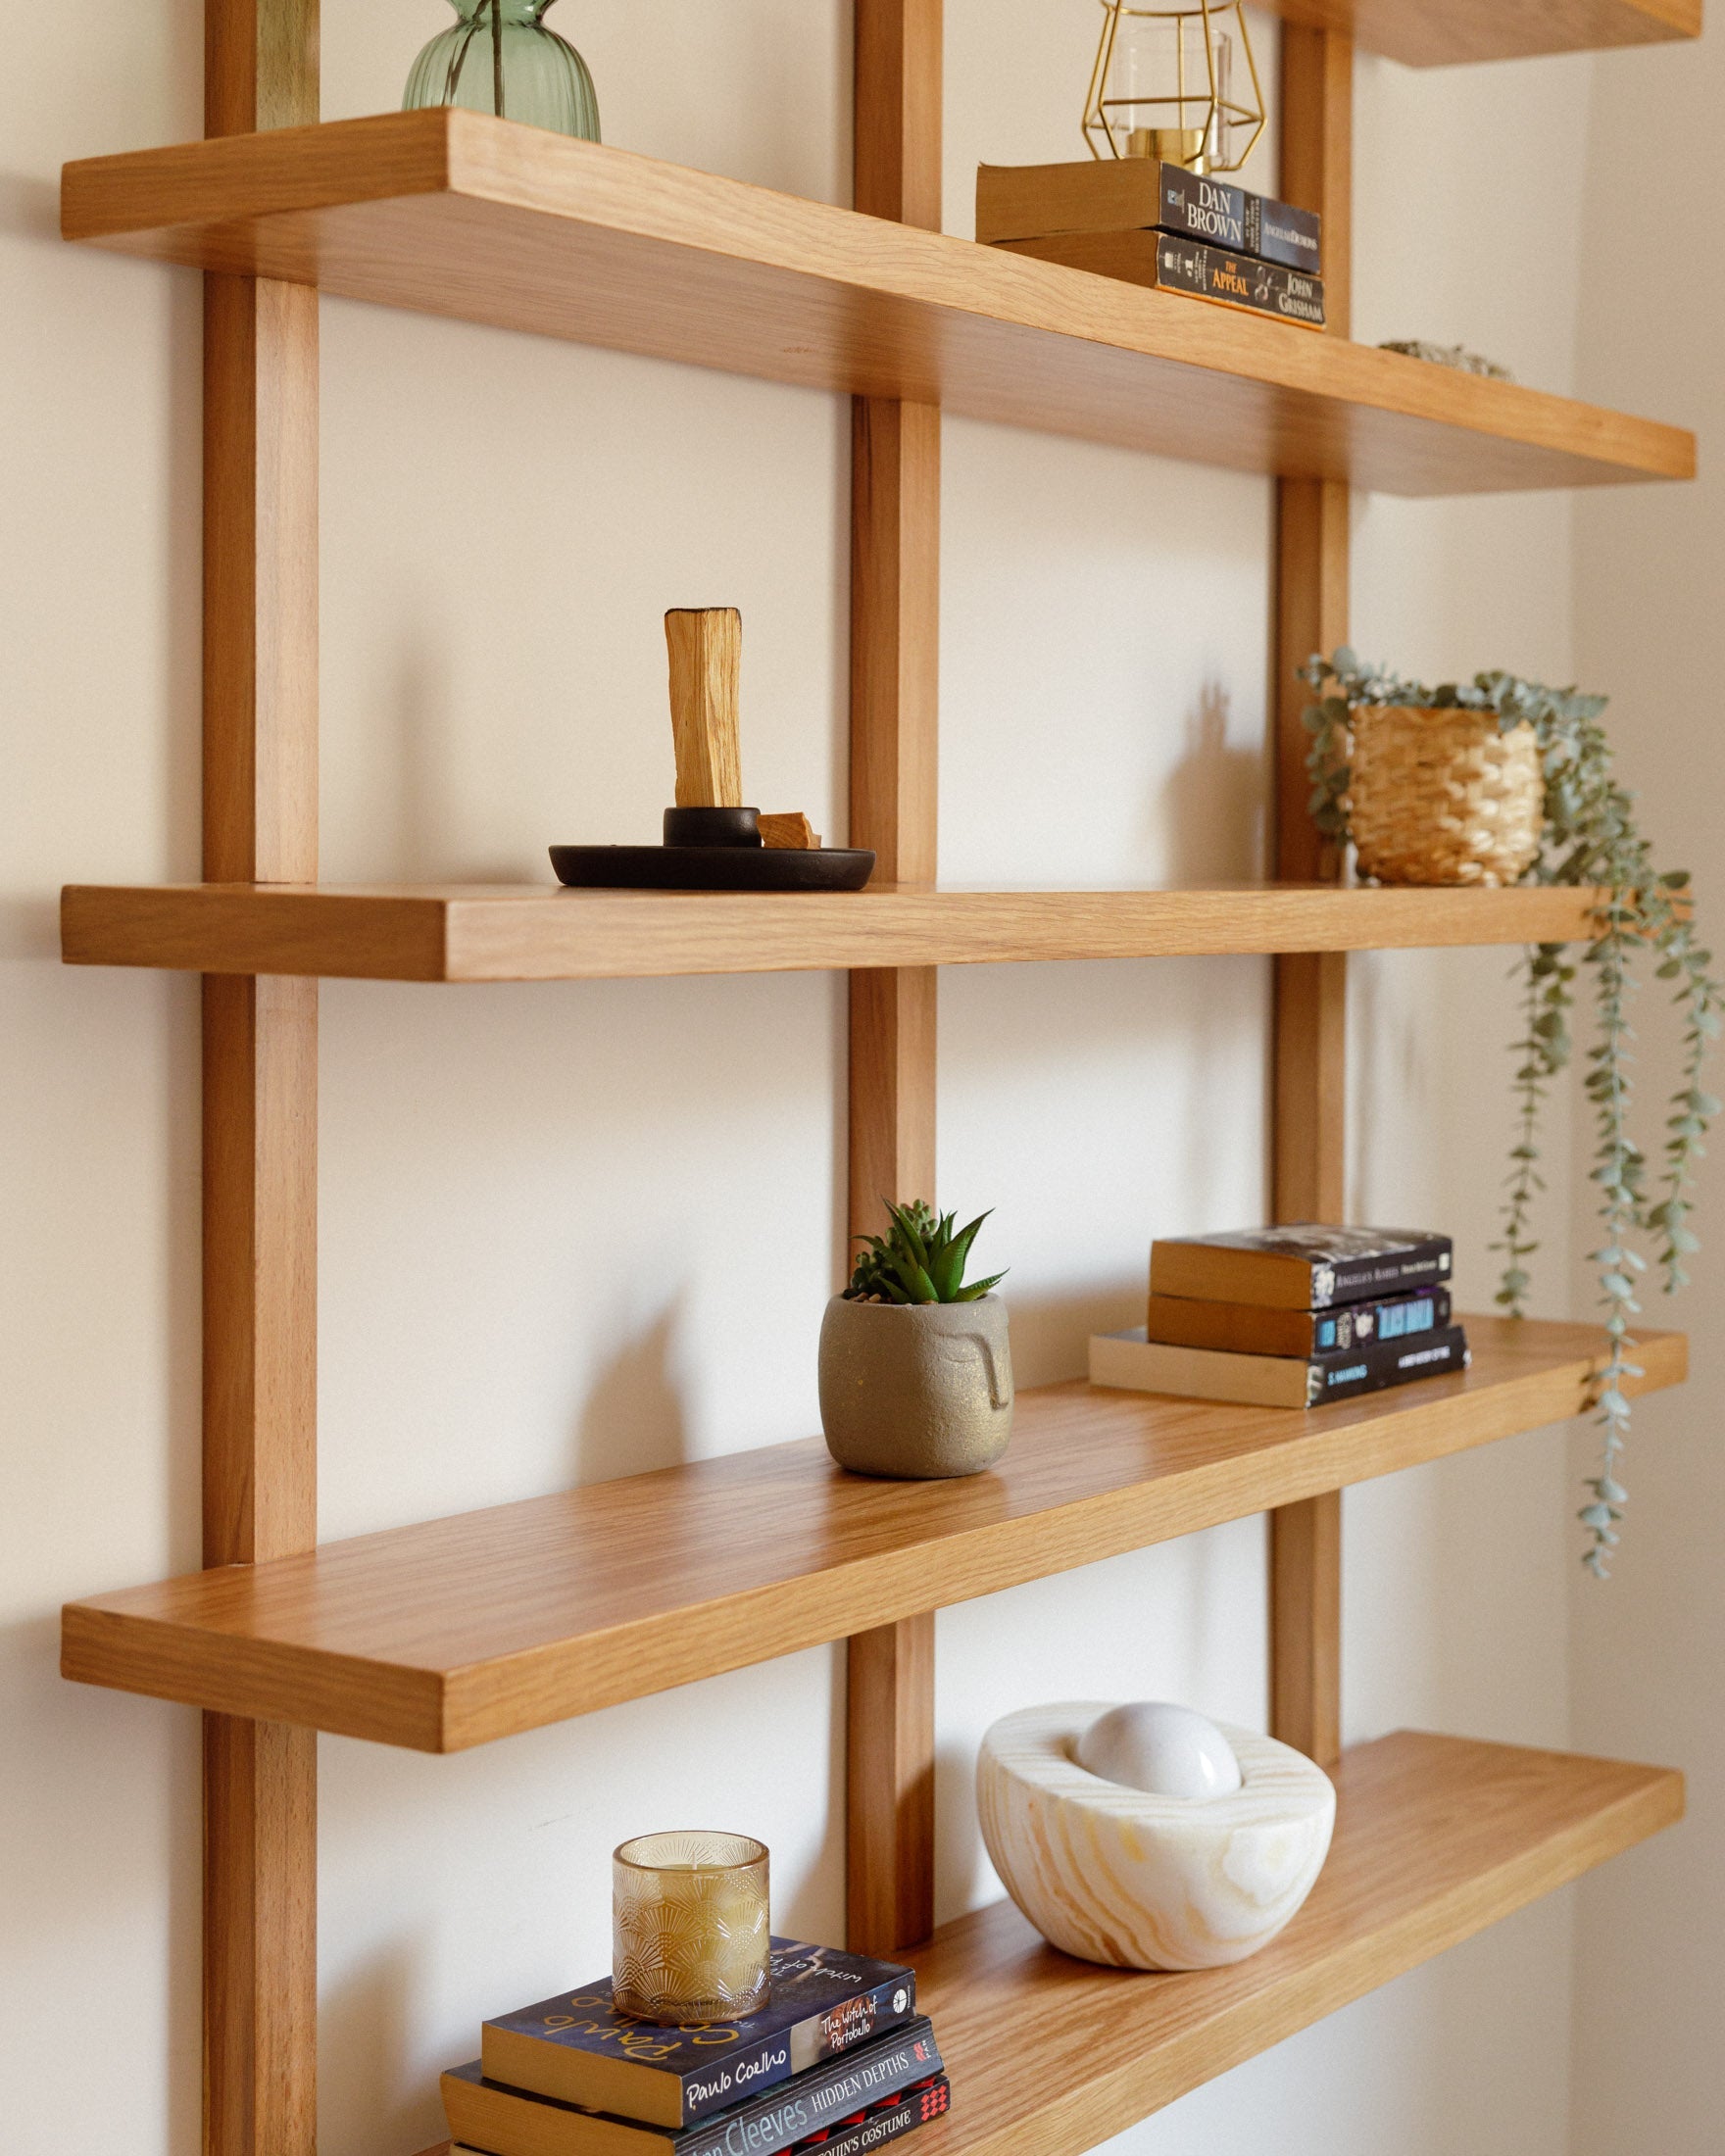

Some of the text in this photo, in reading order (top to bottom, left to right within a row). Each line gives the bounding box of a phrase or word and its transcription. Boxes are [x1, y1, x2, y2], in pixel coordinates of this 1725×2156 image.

[1199, 181, 1232, 215] DAN
[1187, 202, 1243, 243] BROWN
[1212, 268, 1250, 297] APPEAL
[1225, 260, 1238, 273] THE
[1286, 271, 1314, 299] JOHN
[1278, 292, 1323, 322] GRISHAM
[782, 1959, 808, 1970] of
[820, 2015, 842, 2034] The
[868, 1994, 878, 2015] of
[543, 2015, 683, 2062] Paulo
[830, 2018, 871, 2049] Portobello
[686, 2049, 787, 2108] Paulo Coelho
[725, 2051, 910, 2156] Cleeves HIDDEN DEPTHS
[861, 2108, 912, 2146] COSTUME
